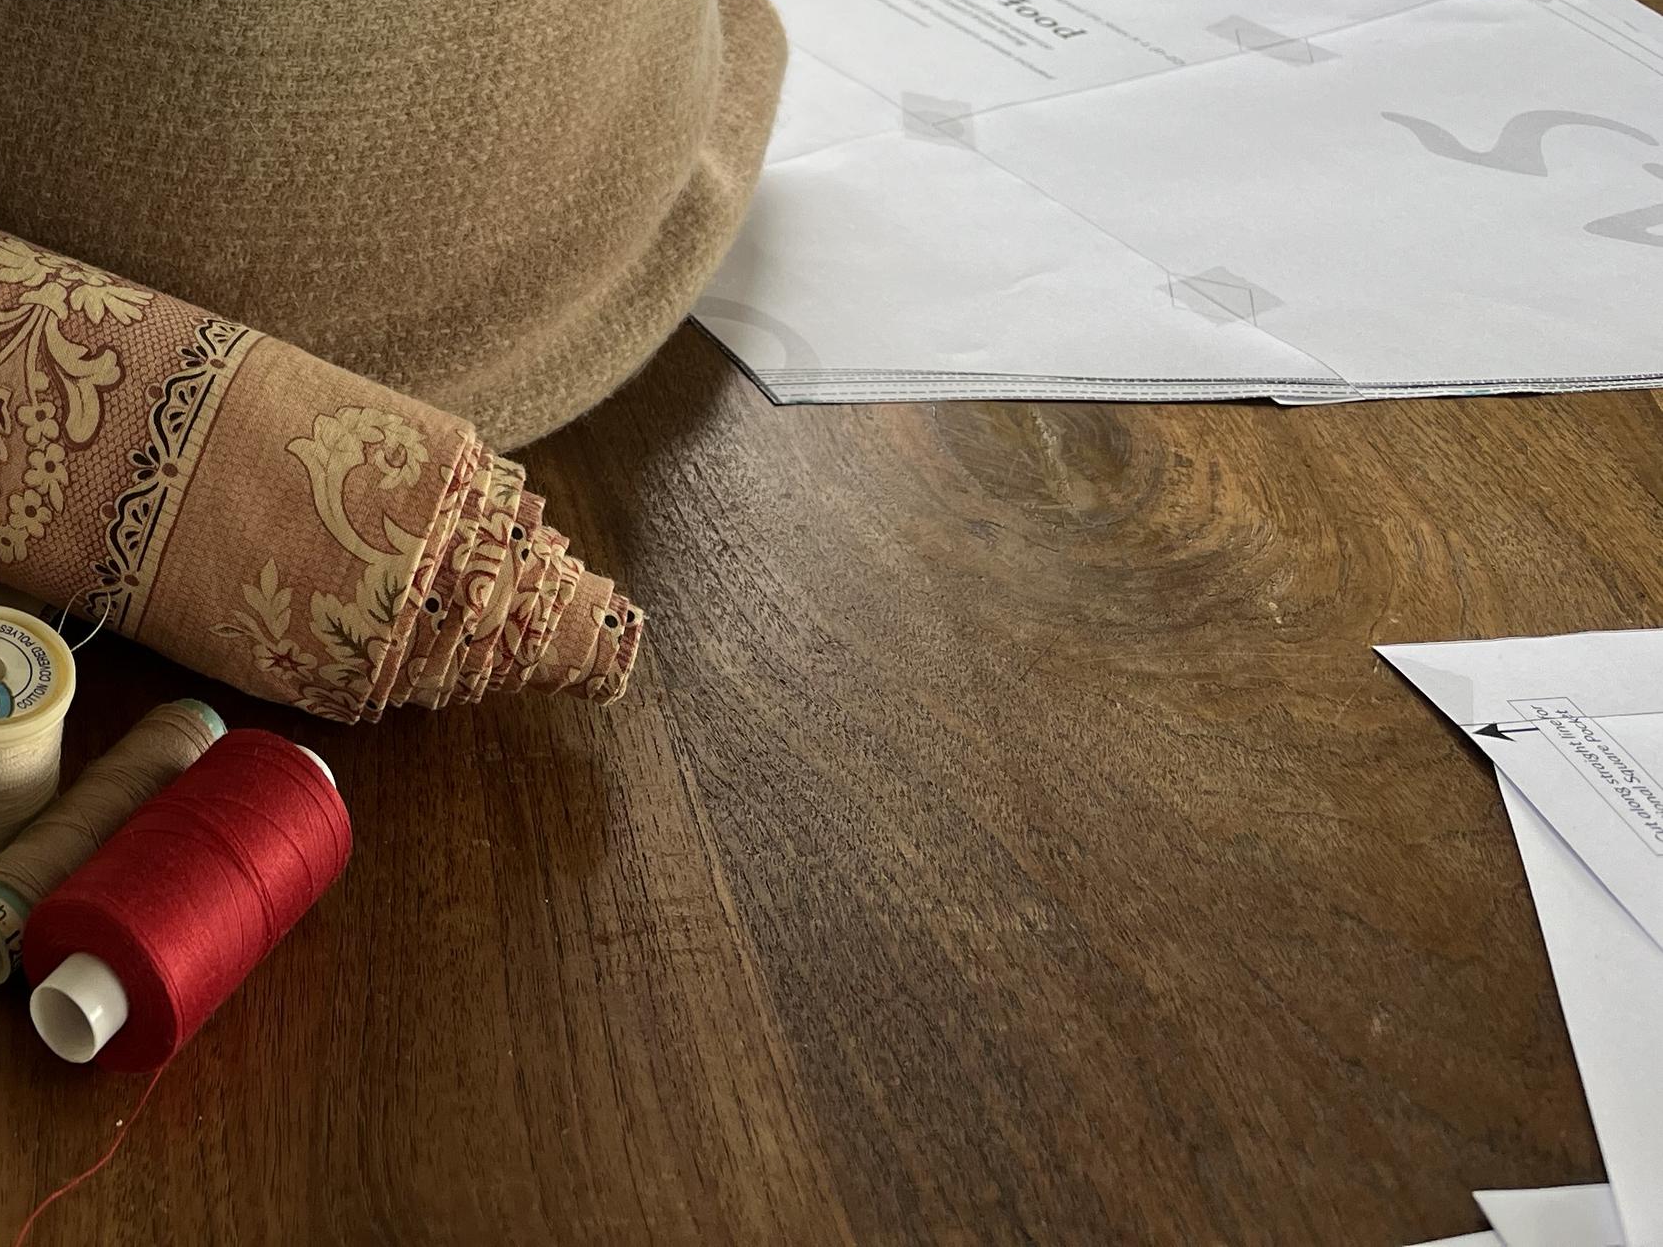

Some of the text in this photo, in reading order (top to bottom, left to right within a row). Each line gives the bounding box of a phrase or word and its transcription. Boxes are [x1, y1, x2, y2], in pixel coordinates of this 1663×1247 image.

[31, 646, 52, 683] COVERED
[16, 683, 49, 710] COTTON
[1530, 704, 1554, 720] for
[1549, 718, 1576, 739] line
[1554, 709, 1602, 743] Pocket
[1568, 740, 1620, 785] straight
[1596, 744, 1641, 784] Square
[1613, 785, 1652, 820] along
